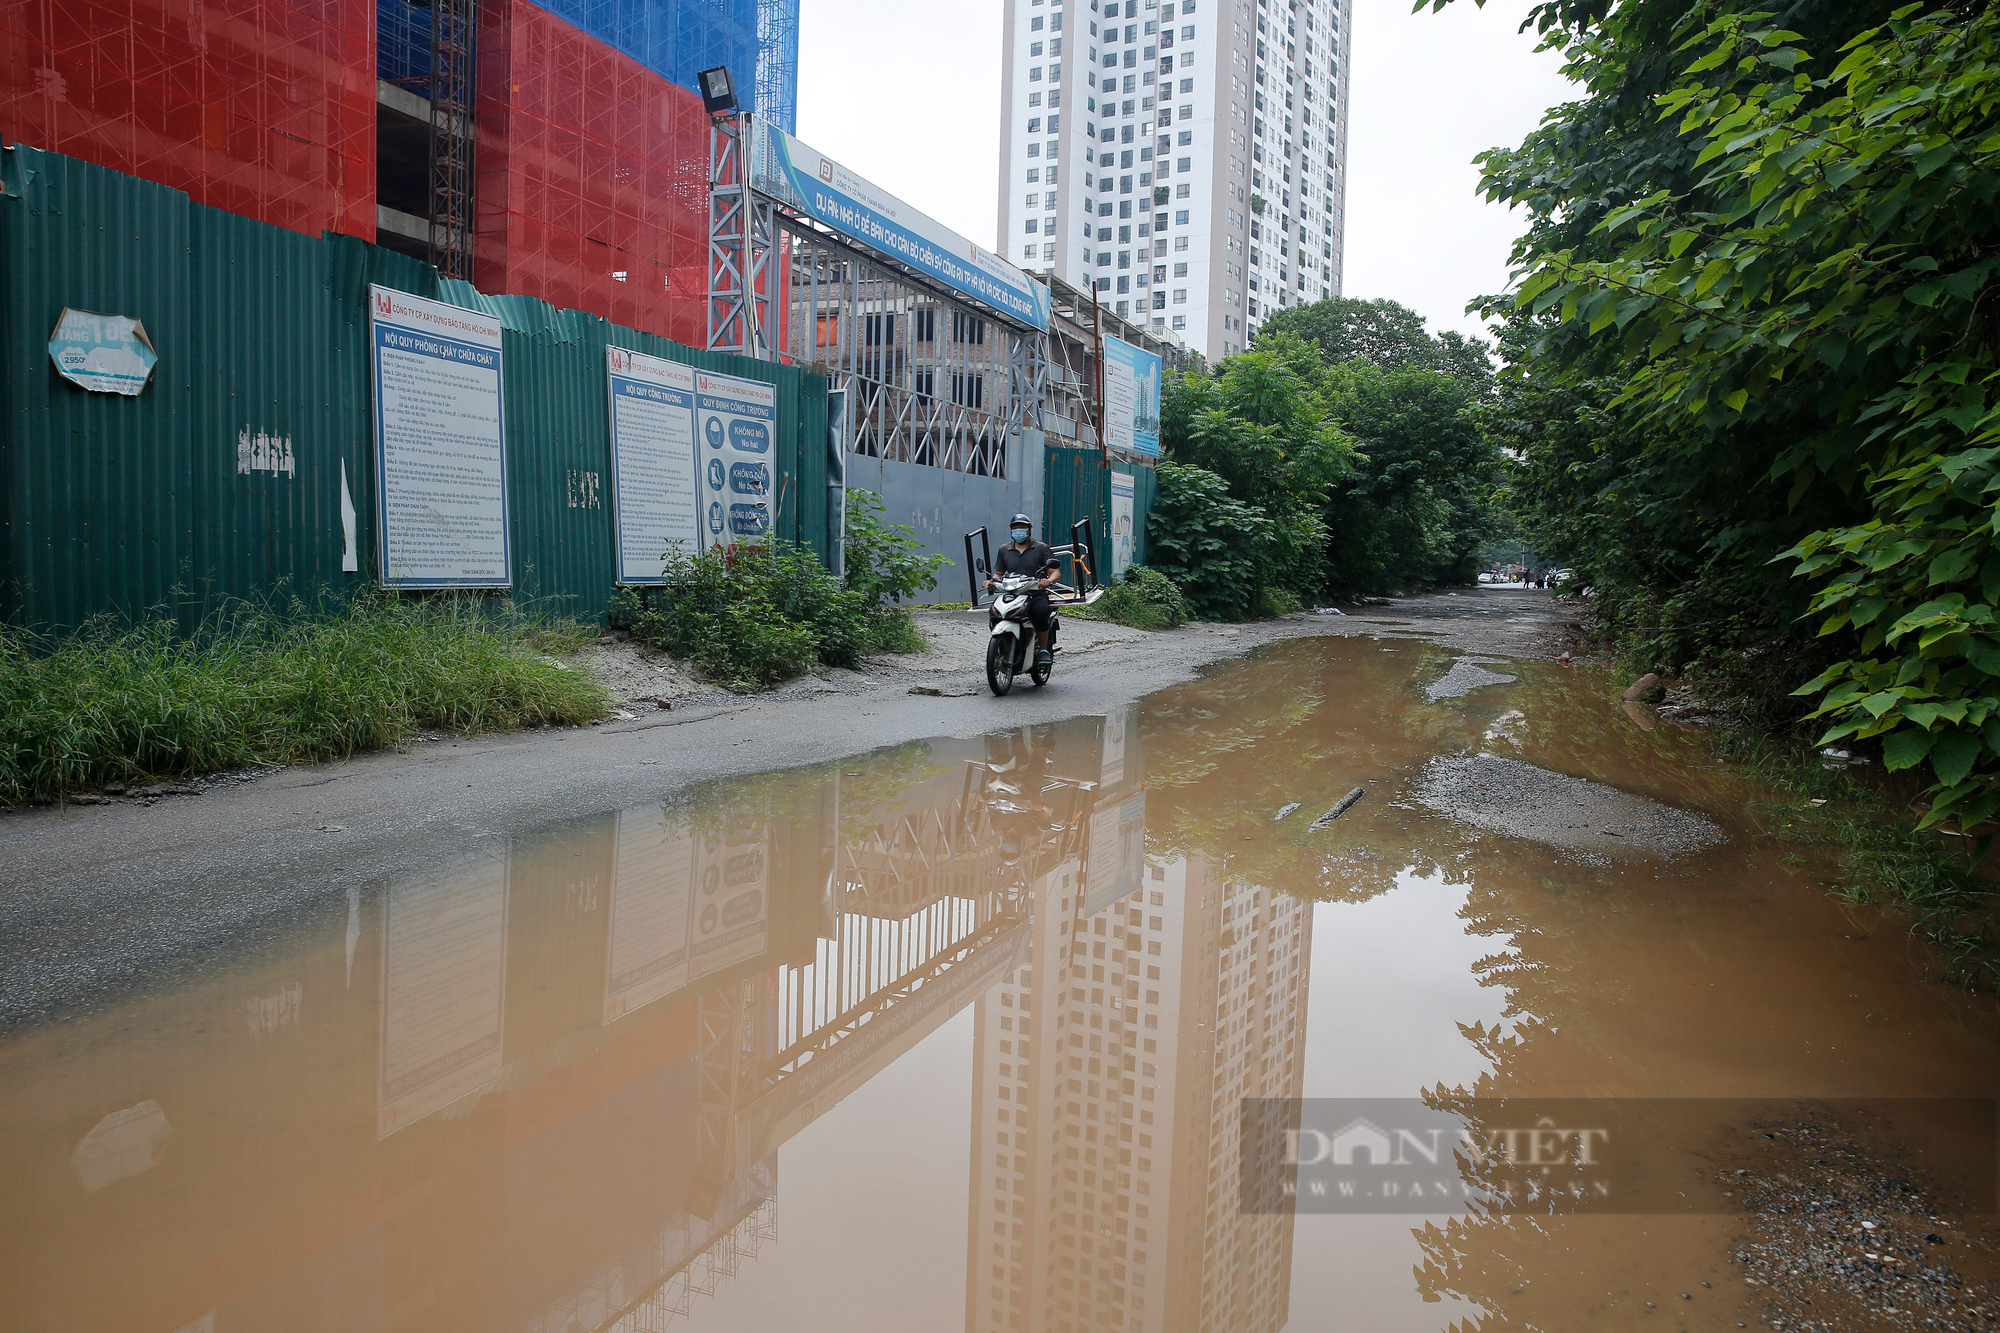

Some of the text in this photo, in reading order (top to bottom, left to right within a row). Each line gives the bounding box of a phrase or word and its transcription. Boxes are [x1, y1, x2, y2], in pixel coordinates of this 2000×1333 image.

[840, 206, 854, 227] NHÀ
[870, 220, 884, 242] BÁN
[884, 230, 897, 249] CHO
[898, 234, 910, 256] CÁN
[942, 258, 956, 279] CÔNG
[956, 266, 964, 283] AN
[964, 269, 971, 286] TP
[970, 272, 978, 290] HÀ
[978, 277, 986, 296] NỘI
[993, 284, 1002, 302] CÁC
[1022, 300, 1033, 317] KHÁC
[392, 304, 408, 316] CÔNG
[408, 308, 414, 317] TY
[415, 310, 422, 319] CP
[423, 311, 433, 322] XÂY
[460, 318, 471, 332] TÀNG
[479, 324, 487, 335] CHÍ
[385, 332, 397, 346] NỘI
[399, 335, 414, 347] QUY
[415, 338, 438, 354] PHÒNG
[458, 346, 475, 360] CHỮA
[476, 352, 494, 366] CHÁY
[626, 384, 636, 396] NỘI
[636, 386, 648, 396] QUY
[648, 388, 661, 400] CÔNG
[702, 397, 715, 408] QUY
[716, 400, 730, 410] ĐỊNH
[730, 402, 746, 413] CÔNG
[734, 425, 754, 437] KHÔNG
[742, 439, 749, 447] No
[732, 468, 754, 479] KHÔNG
[738, 481, 746, 490] No
